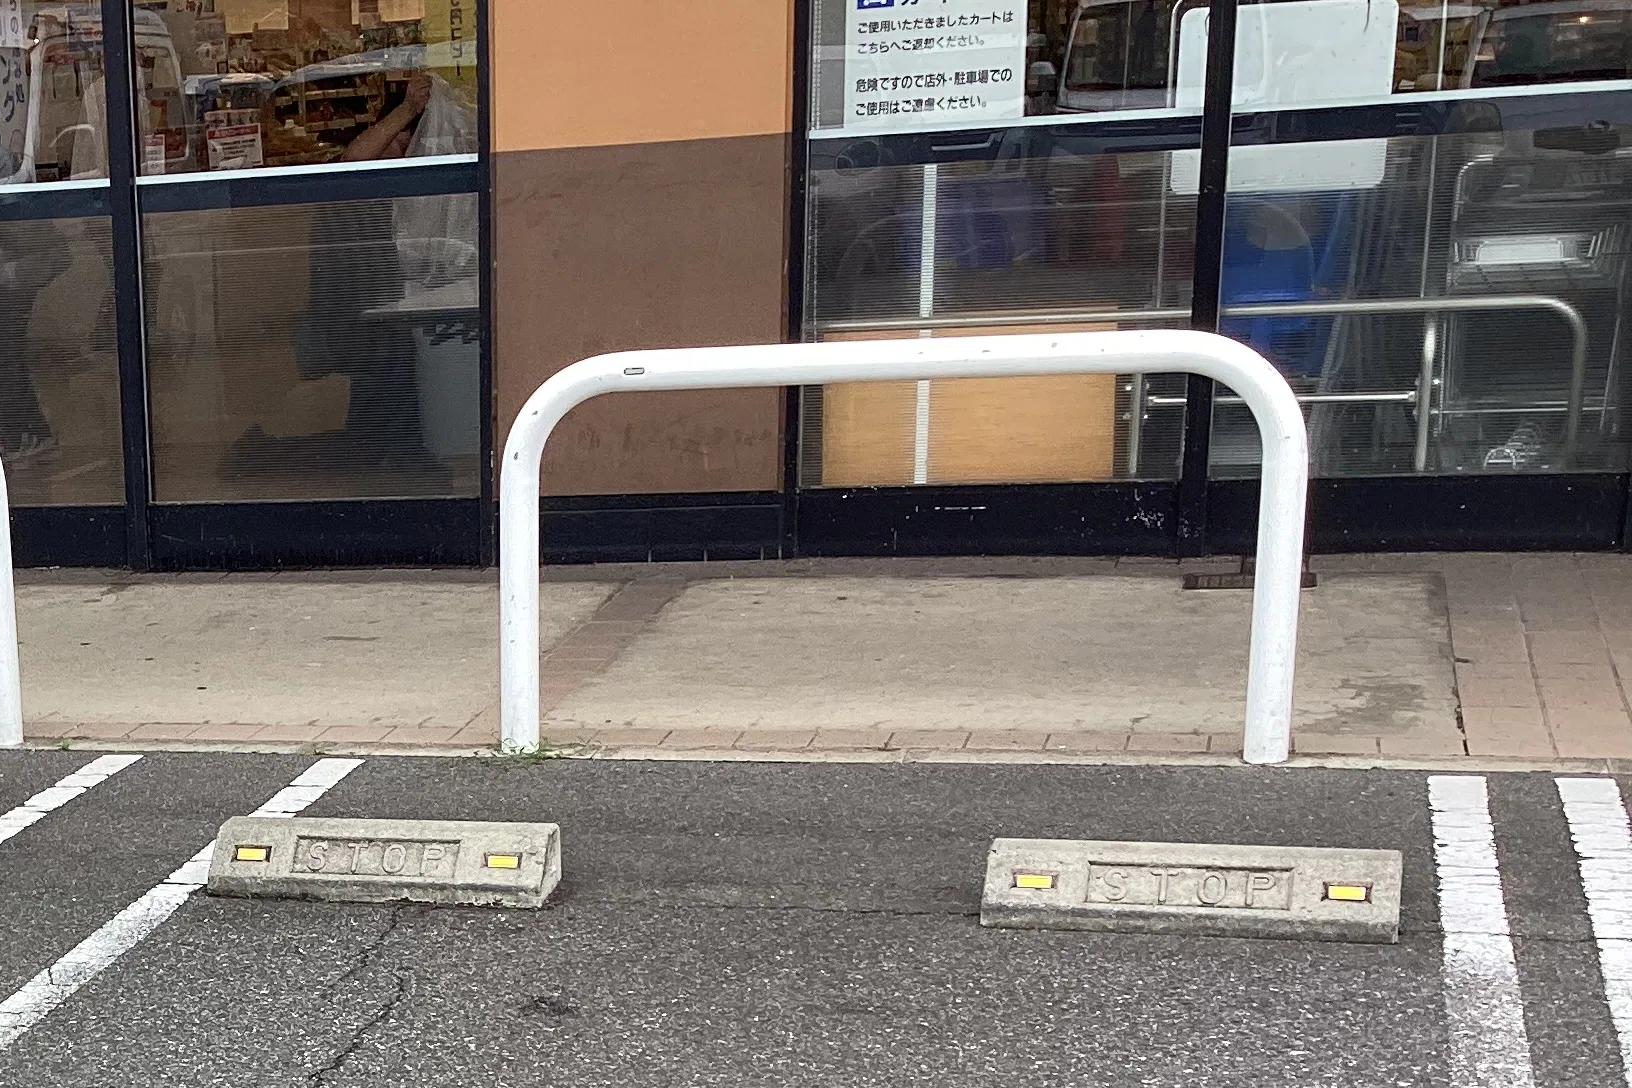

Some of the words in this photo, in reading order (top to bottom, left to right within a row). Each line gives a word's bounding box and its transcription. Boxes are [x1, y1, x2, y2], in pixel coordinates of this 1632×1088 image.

[857, 10, 1014, 34] ご使用いただきましたカートは
[857, 35, 985, 54] こちらへご返却ください。
[855, 68, 1013, 93] 危険ですので店外・駐車場での
[855, 96, 987, 116] ご使用はご遠慮ください。
[306, 840, 450, 877] STOP
[1102, 870, 1276, 908] STOP
